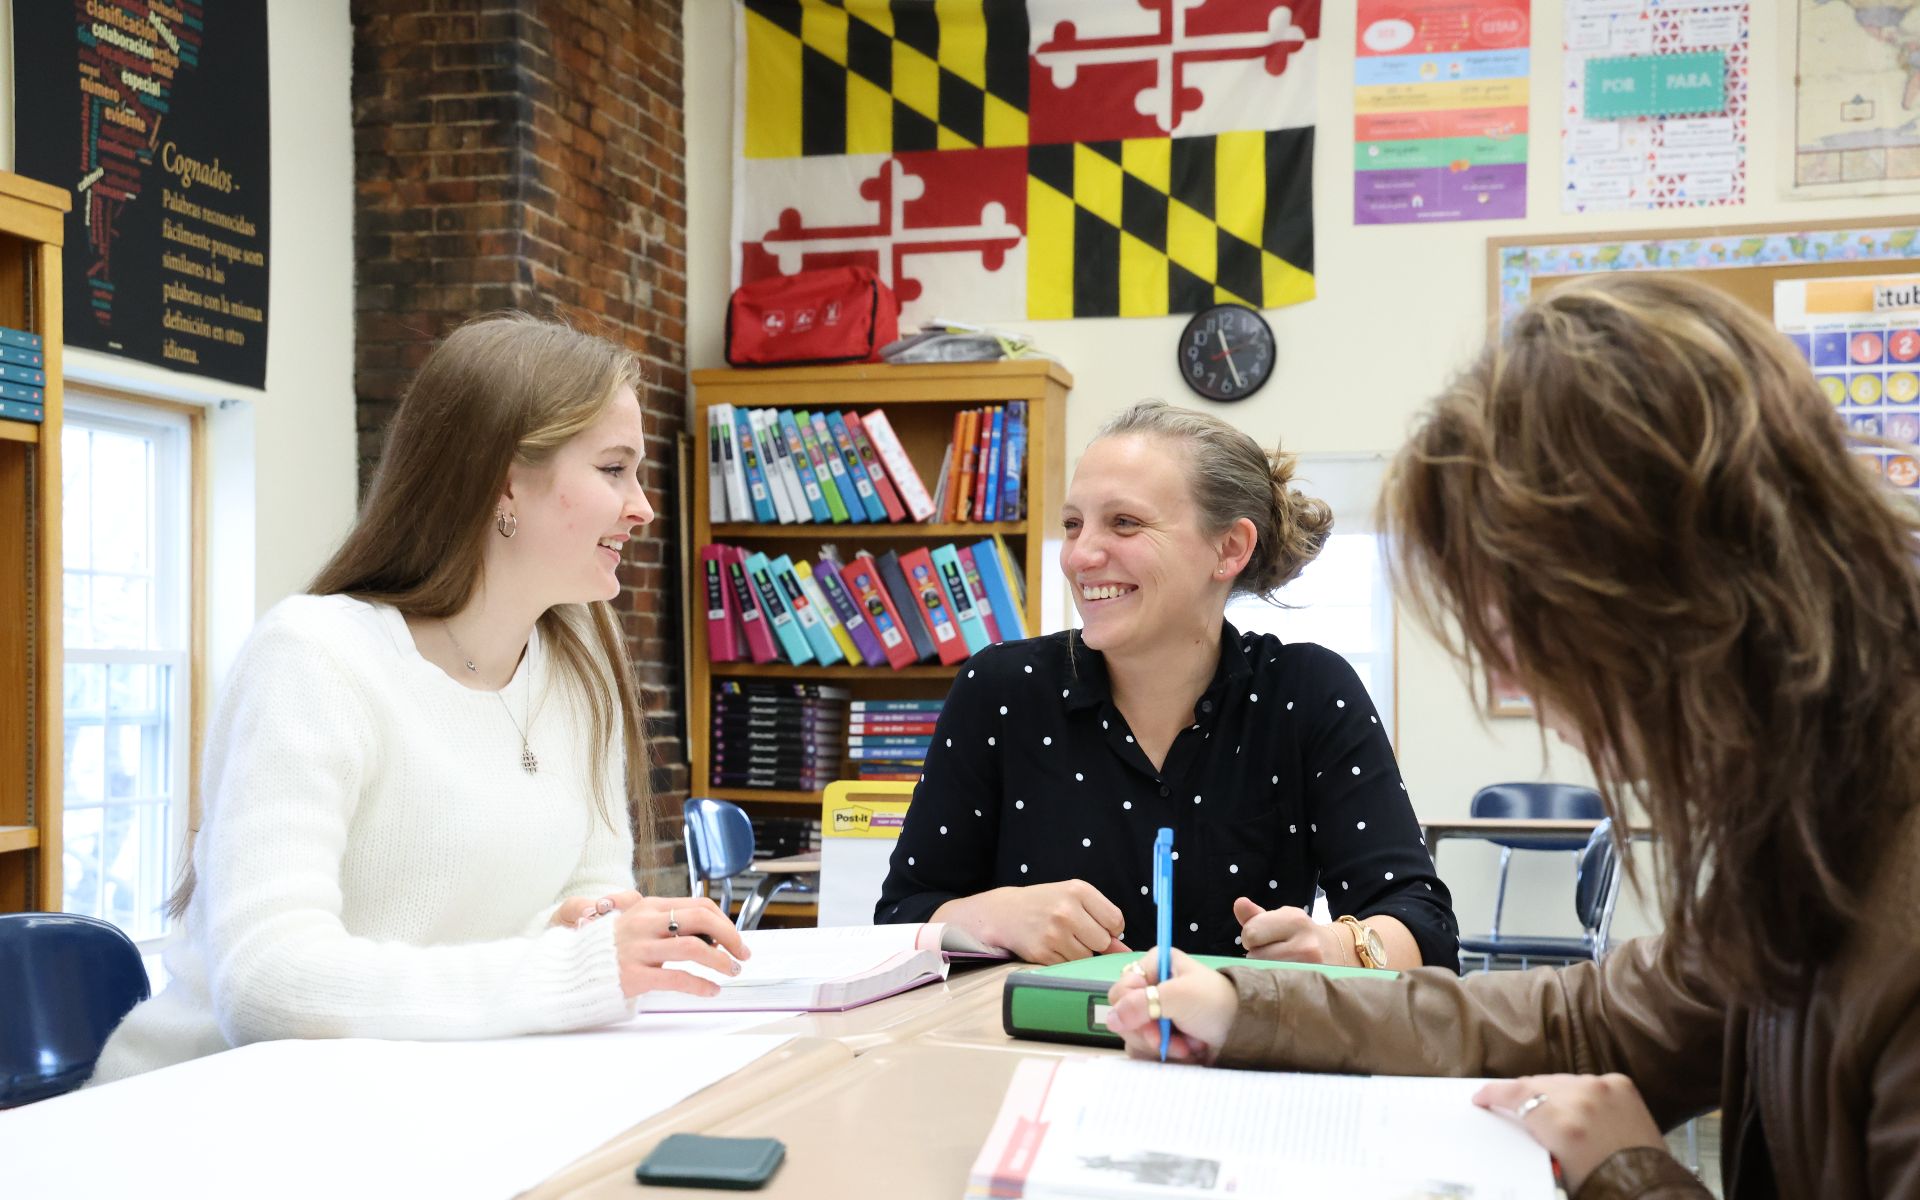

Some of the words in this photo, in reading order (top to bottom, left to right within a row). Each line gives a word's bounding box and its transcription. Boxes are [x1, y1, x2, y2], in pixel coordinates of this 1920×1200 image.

[92, 22, 154, 60] colaboración
[81, 76, 120, 103] número
[121, 70, 160, 97] especial
[1601, 77, 1635, 94] POR
[1665, 72, 1712, 90] PARA
[105, 107, 146, 133] evidente
[162, 188, 201, 220] Palabras
[202, 207, 256, 237] reconocidas
[211, 239, 242, 264] porque
[243, 250, 264, 267] son
[163, 251, 205, 279] similares
[206, 266, 212, 281] a
[163, 281, 202, 307] palabras
[203, 295, 220, 312] con
[221, 294, 230, 315] la
[231, 302, 263, 323] misma
[163, 308, 211, 339] definición
[212, 326, 224, 341] en
[225, 328, 245, 346] otro
[1219, 311, 1234, 331] 12
[1187, 346, 1200, 361] 9
[1256, 342, 1267, 360] 3
[1861, 340, 1871, 359] 1
[1899, 335, 1914, 355] 2
[1193, 361, 1204, 378] 8
[1250, 362, 1260, 376] 4
[1207, 372, 1217, 388] 7
[1221, 378, 1233, 393] 6
[1858, 380, 1874, 398] 8
[1896, 378, 1911, 397] 9
[1853, 418, 1878, 436] 15
[1893, 420, 1911, 439] 16
[1889, 462, 1918, 485] 23
[836, 813, 868, 823] Post-it
